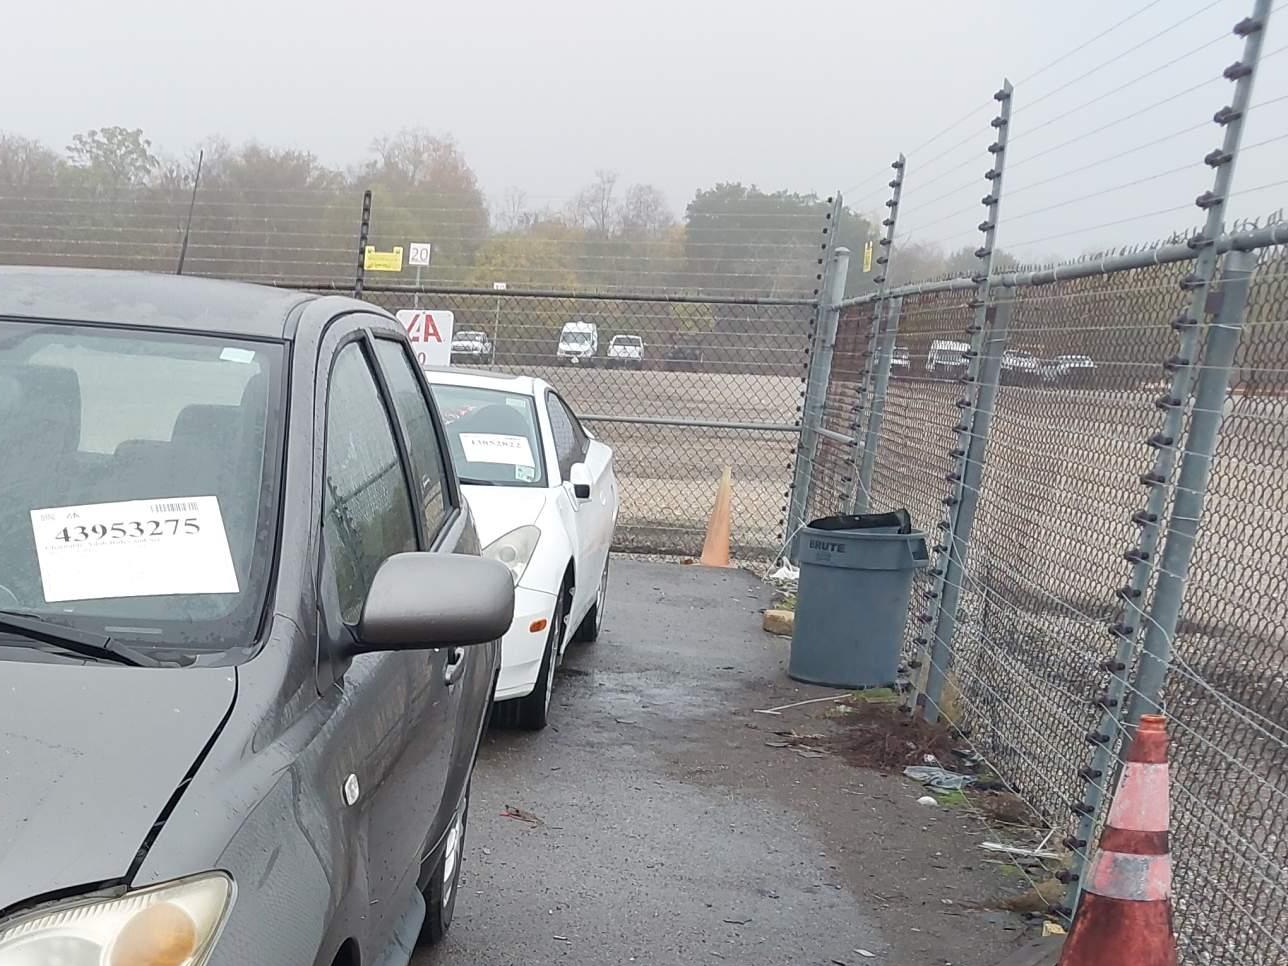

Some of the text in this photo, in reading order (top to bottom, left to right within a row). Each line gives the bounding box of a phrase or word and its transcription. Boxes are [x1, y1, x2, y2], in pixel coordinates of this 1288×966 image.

[411, 247, 429, 262] 20
[55, 517, 200, 543] 43953275
[809, 539, 847, 553] BRUTE
